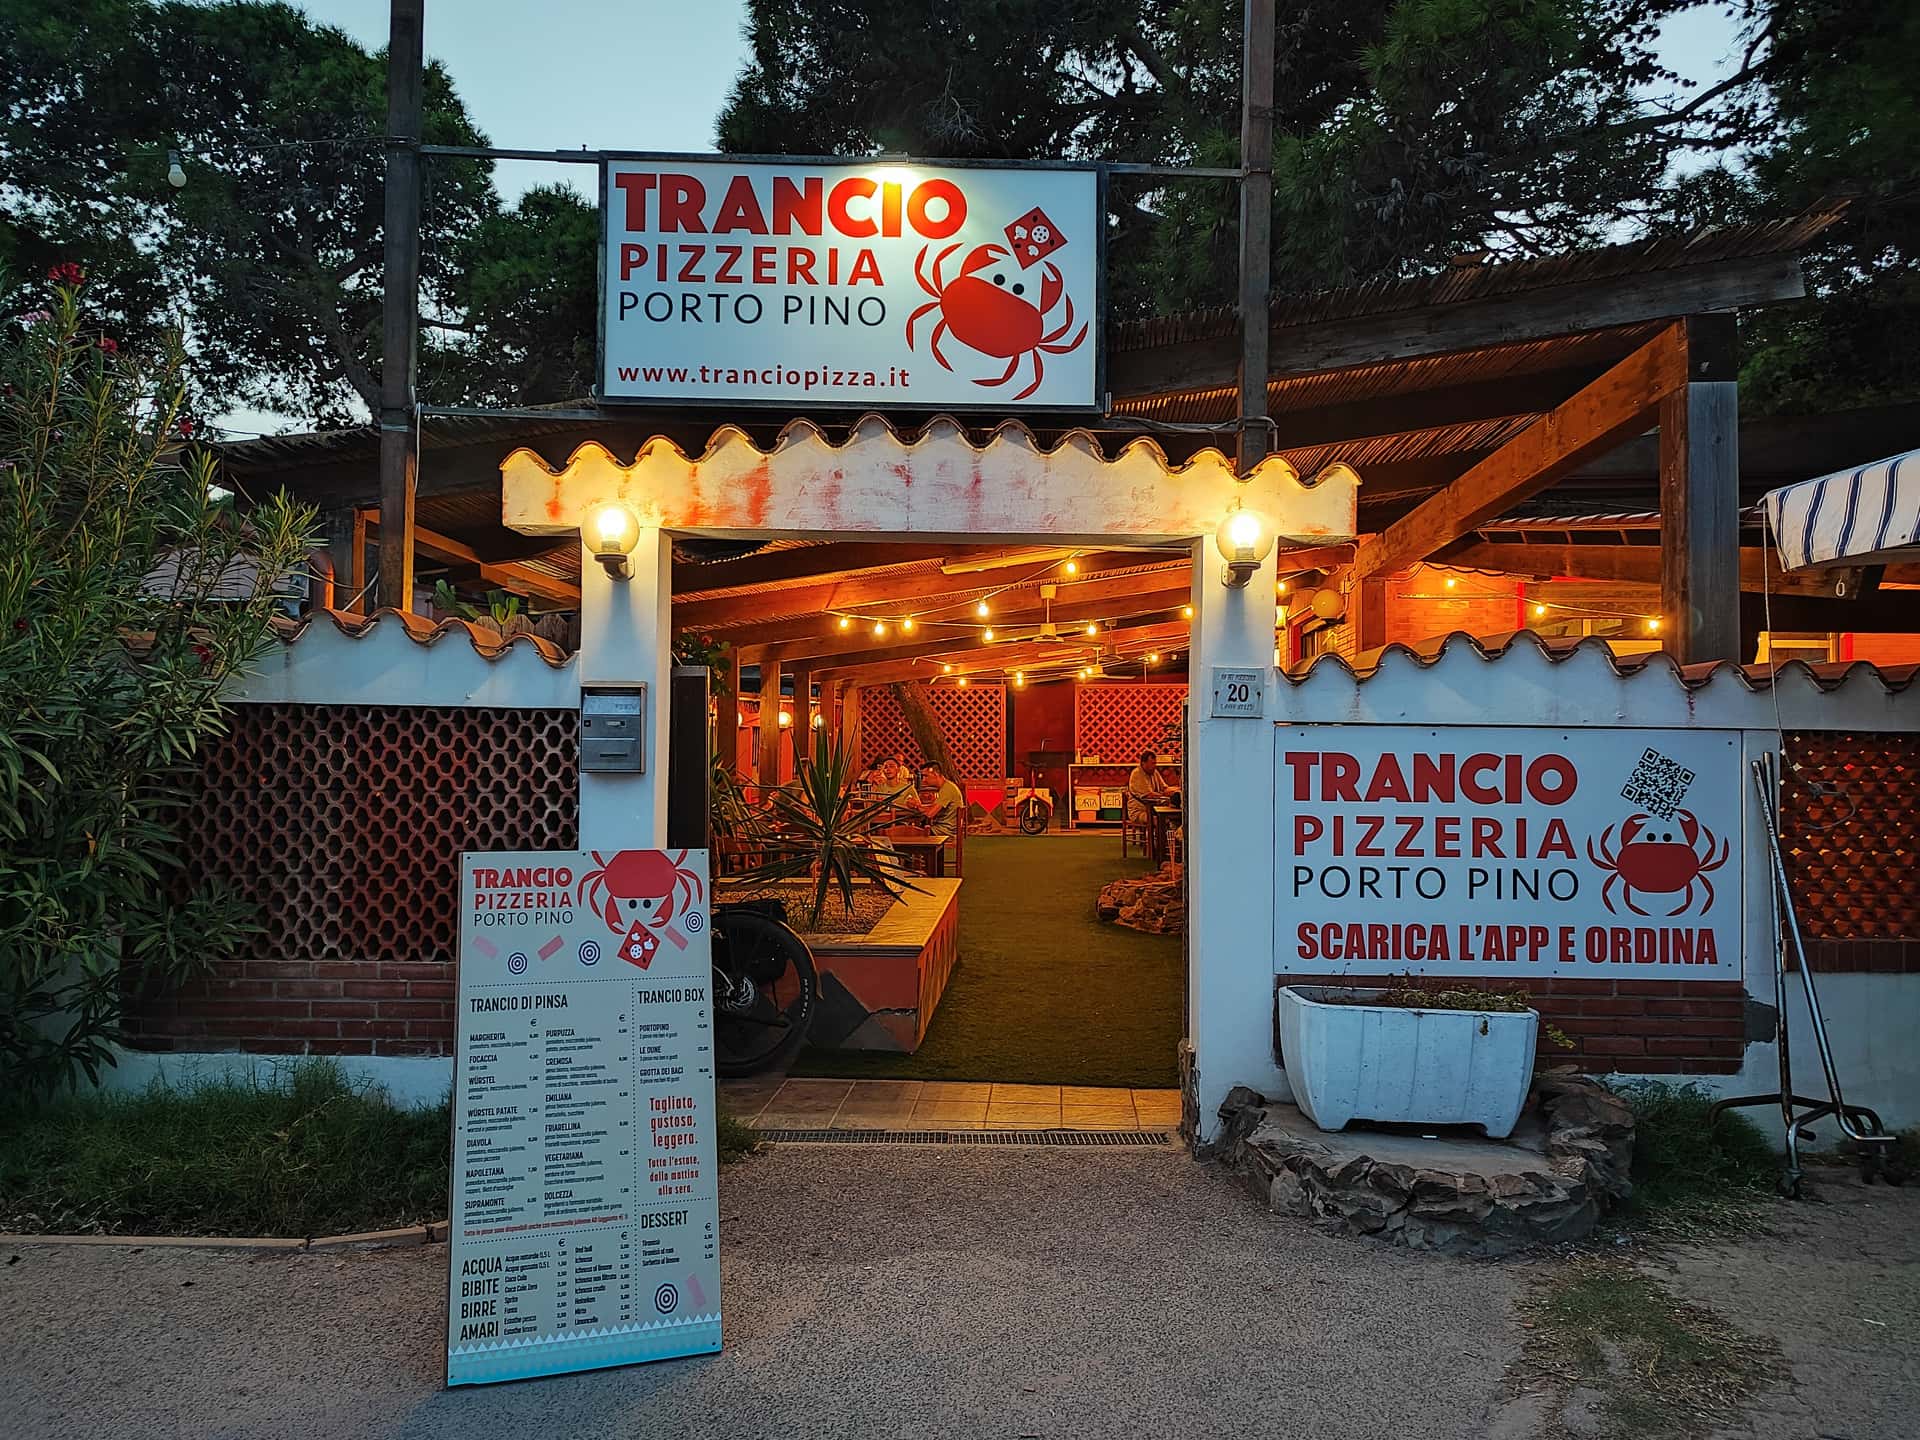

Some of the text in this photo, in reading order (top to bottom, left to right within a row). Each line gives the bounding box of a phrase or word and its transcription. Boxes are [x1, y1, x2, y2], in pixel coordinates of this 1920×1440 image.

[615, 172, 968, 239] TRANCIO
[620, 243, 884, 286] PIZZERIA
[619, 292, 886, 326] PORTO PINO
[618, 364, 910, 392] www.tranciopizza.it
[1228, 683, 1249, 702] 20
[1285, 752, 1578, 805] TRANCIO
[1294, 816, 1577, 860] PIZZERIA
[472, 867, 573, 889] TRANCIO
[1293, 865, 1580, 901] PORTO PINO
[474, 892, 573, 910] PIZZERIA
[474, 910, 574, 926] PORTO PINO
[1297, 922, 1718, 965] SCARICA L'APP E ORDINA
[470, 994, 568, 1013] TRANCIO DI PINSA
[638, 988, 705, 1004] TRANCIO BOX
[469, 1032, 506, 1042] MARGHERITA
[469, 1054, 498, 1064] FOCACCIA
[496, 1106, 518, 1116] PATATE
[650, 1115, 697, 1132] gustosa,
[466, 1138, 492, 1148] DIAVOLA
[653, 1132, 699, 1149] leggera.
[544, 1151, 583, 1162] VEGETARIANA
[466, 1167, 505, 1178] NAPOLETANA
[464, 1197, 505, 1209] SUPRAMONTE
[544, 1189, 573, 1201] DOLCEZZA
[641, 1210, 688, 1229] DESSERT
[462, 1257, 502, 1276] ACQUA
[462, 1278, 500, 1297] BIBITE
[461, 1300, 497, 1319] BIRRE
[460, 1320, 499, 1341] AMARI
